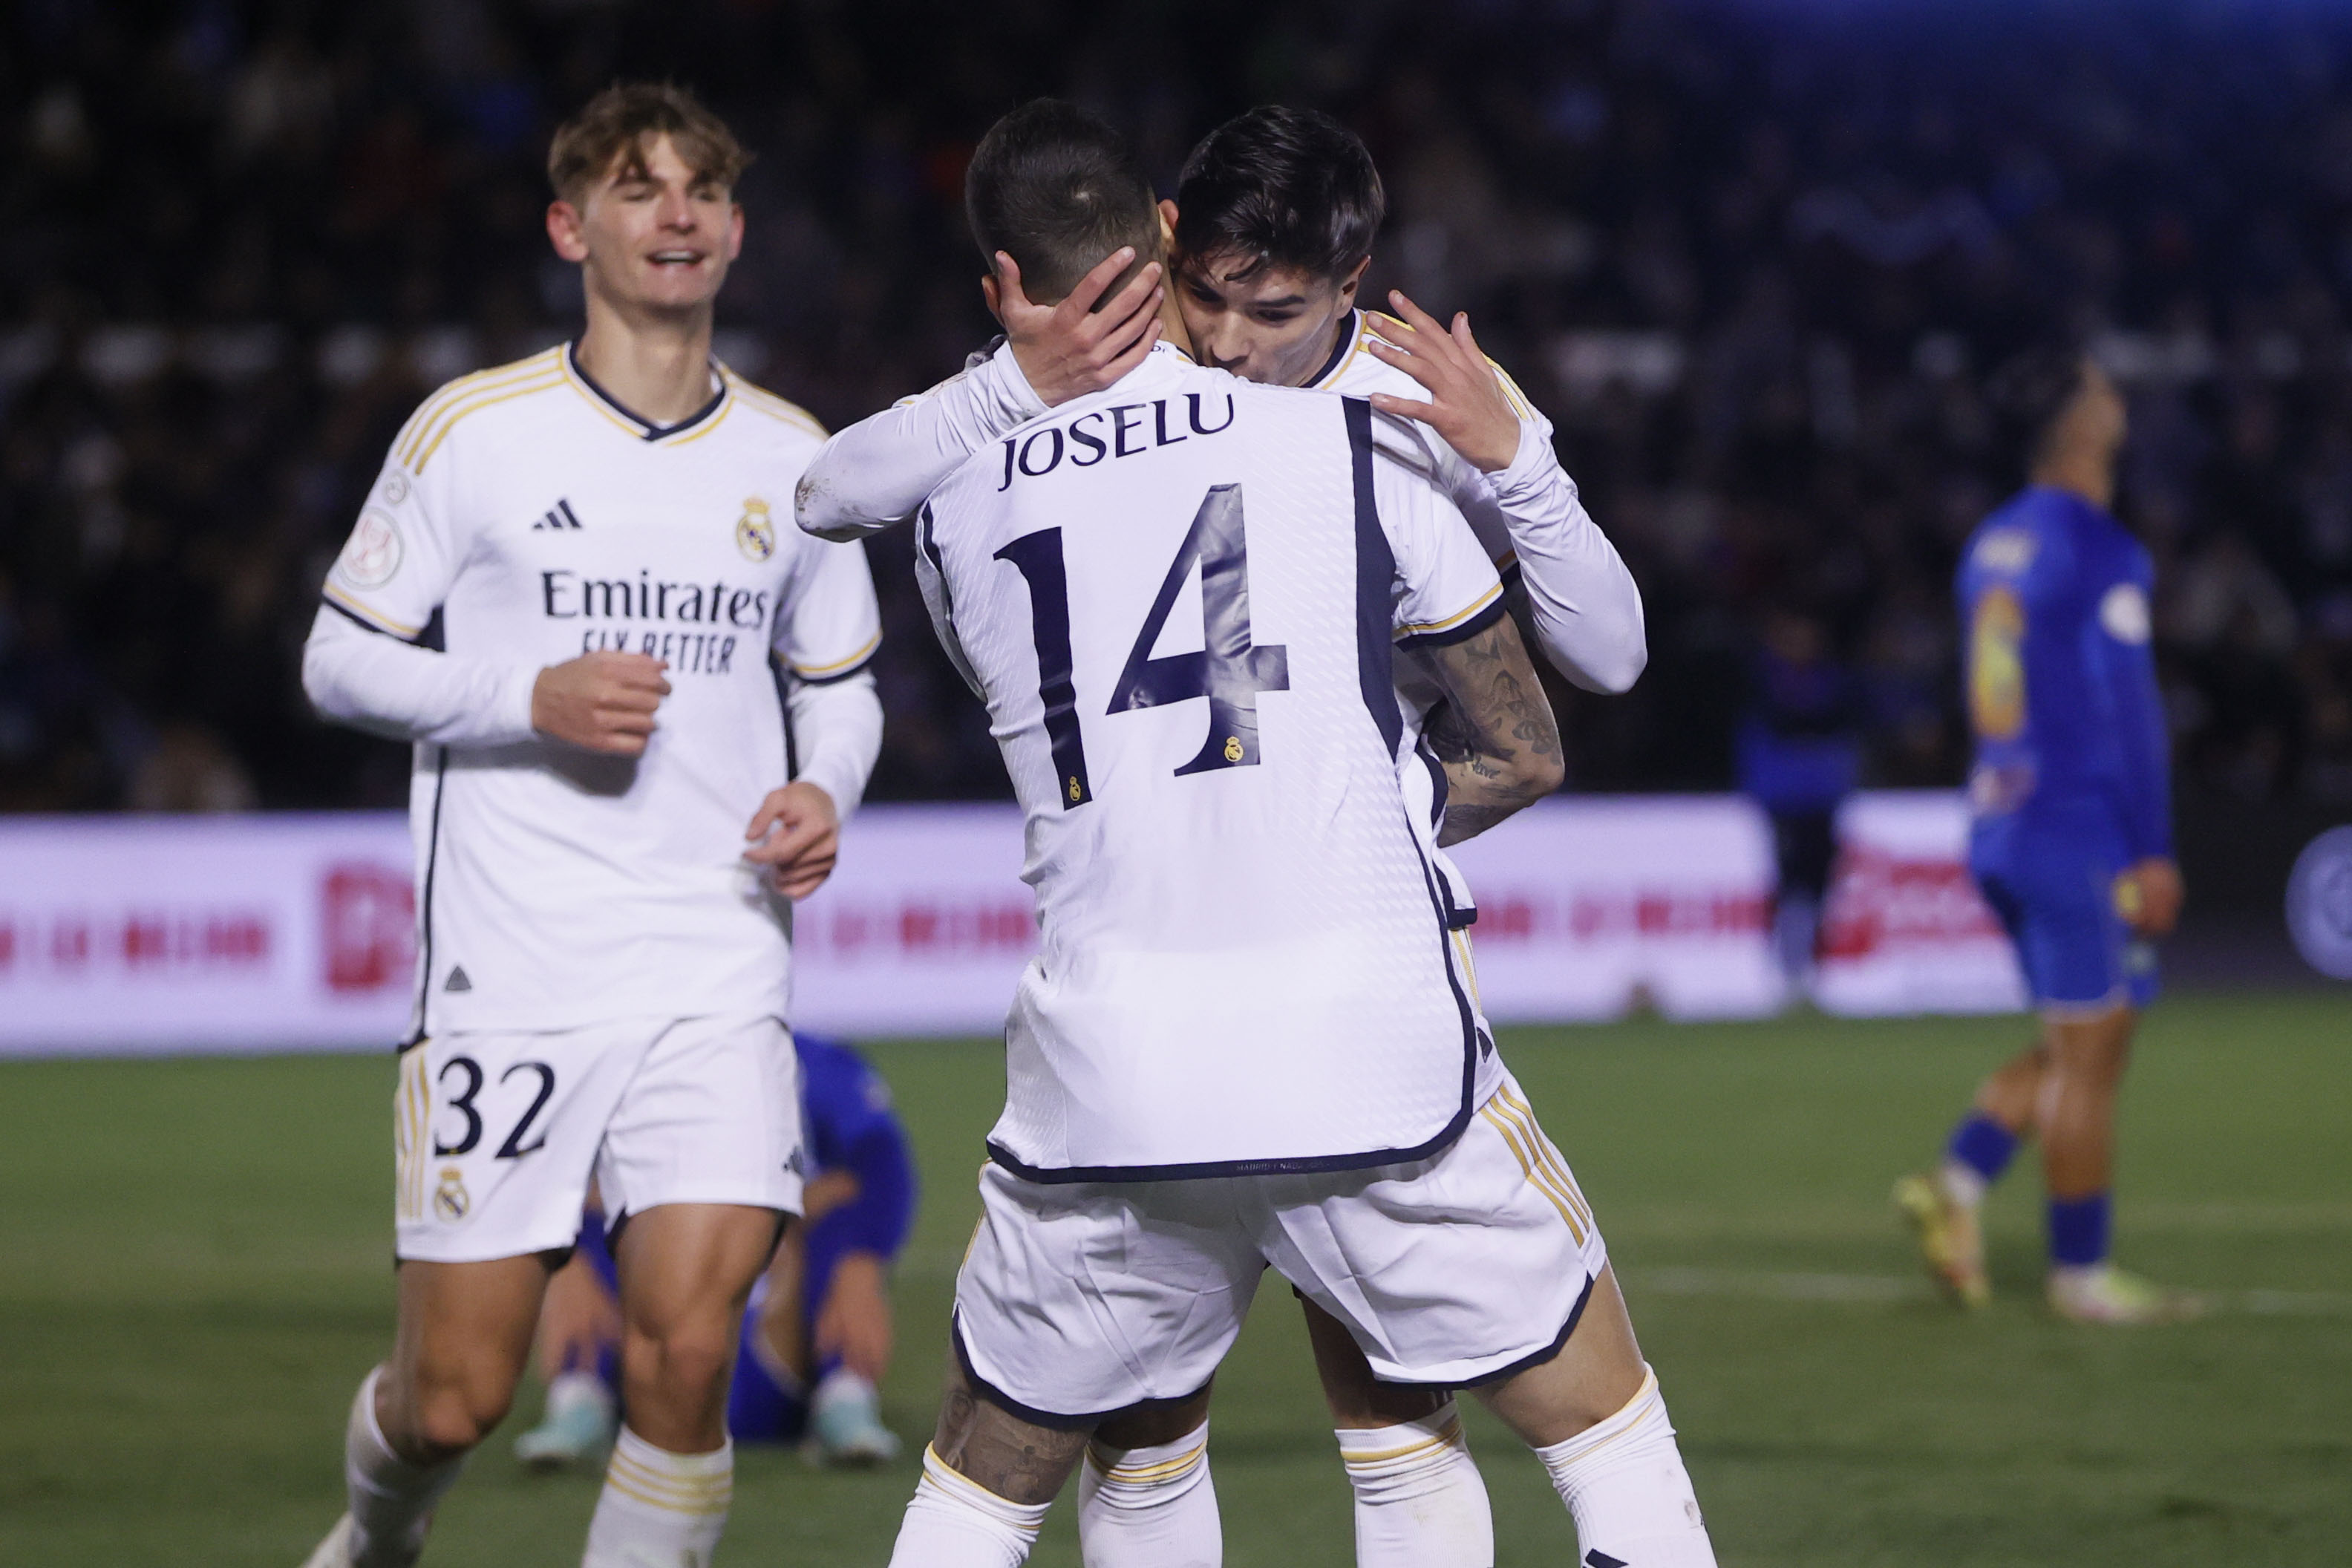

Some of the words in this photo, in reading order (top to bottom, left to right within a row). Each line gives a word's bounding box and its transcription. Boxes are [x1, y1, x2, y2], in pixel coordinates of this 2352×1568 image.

[997, 393, 1235, 493] JOSELU
[541, 568, 768, 630] Emirates
[993, 482, 1290, 811] 14
[642, 631, 736, 674] BETTER
[434, 1056, 555, 1160] 32
